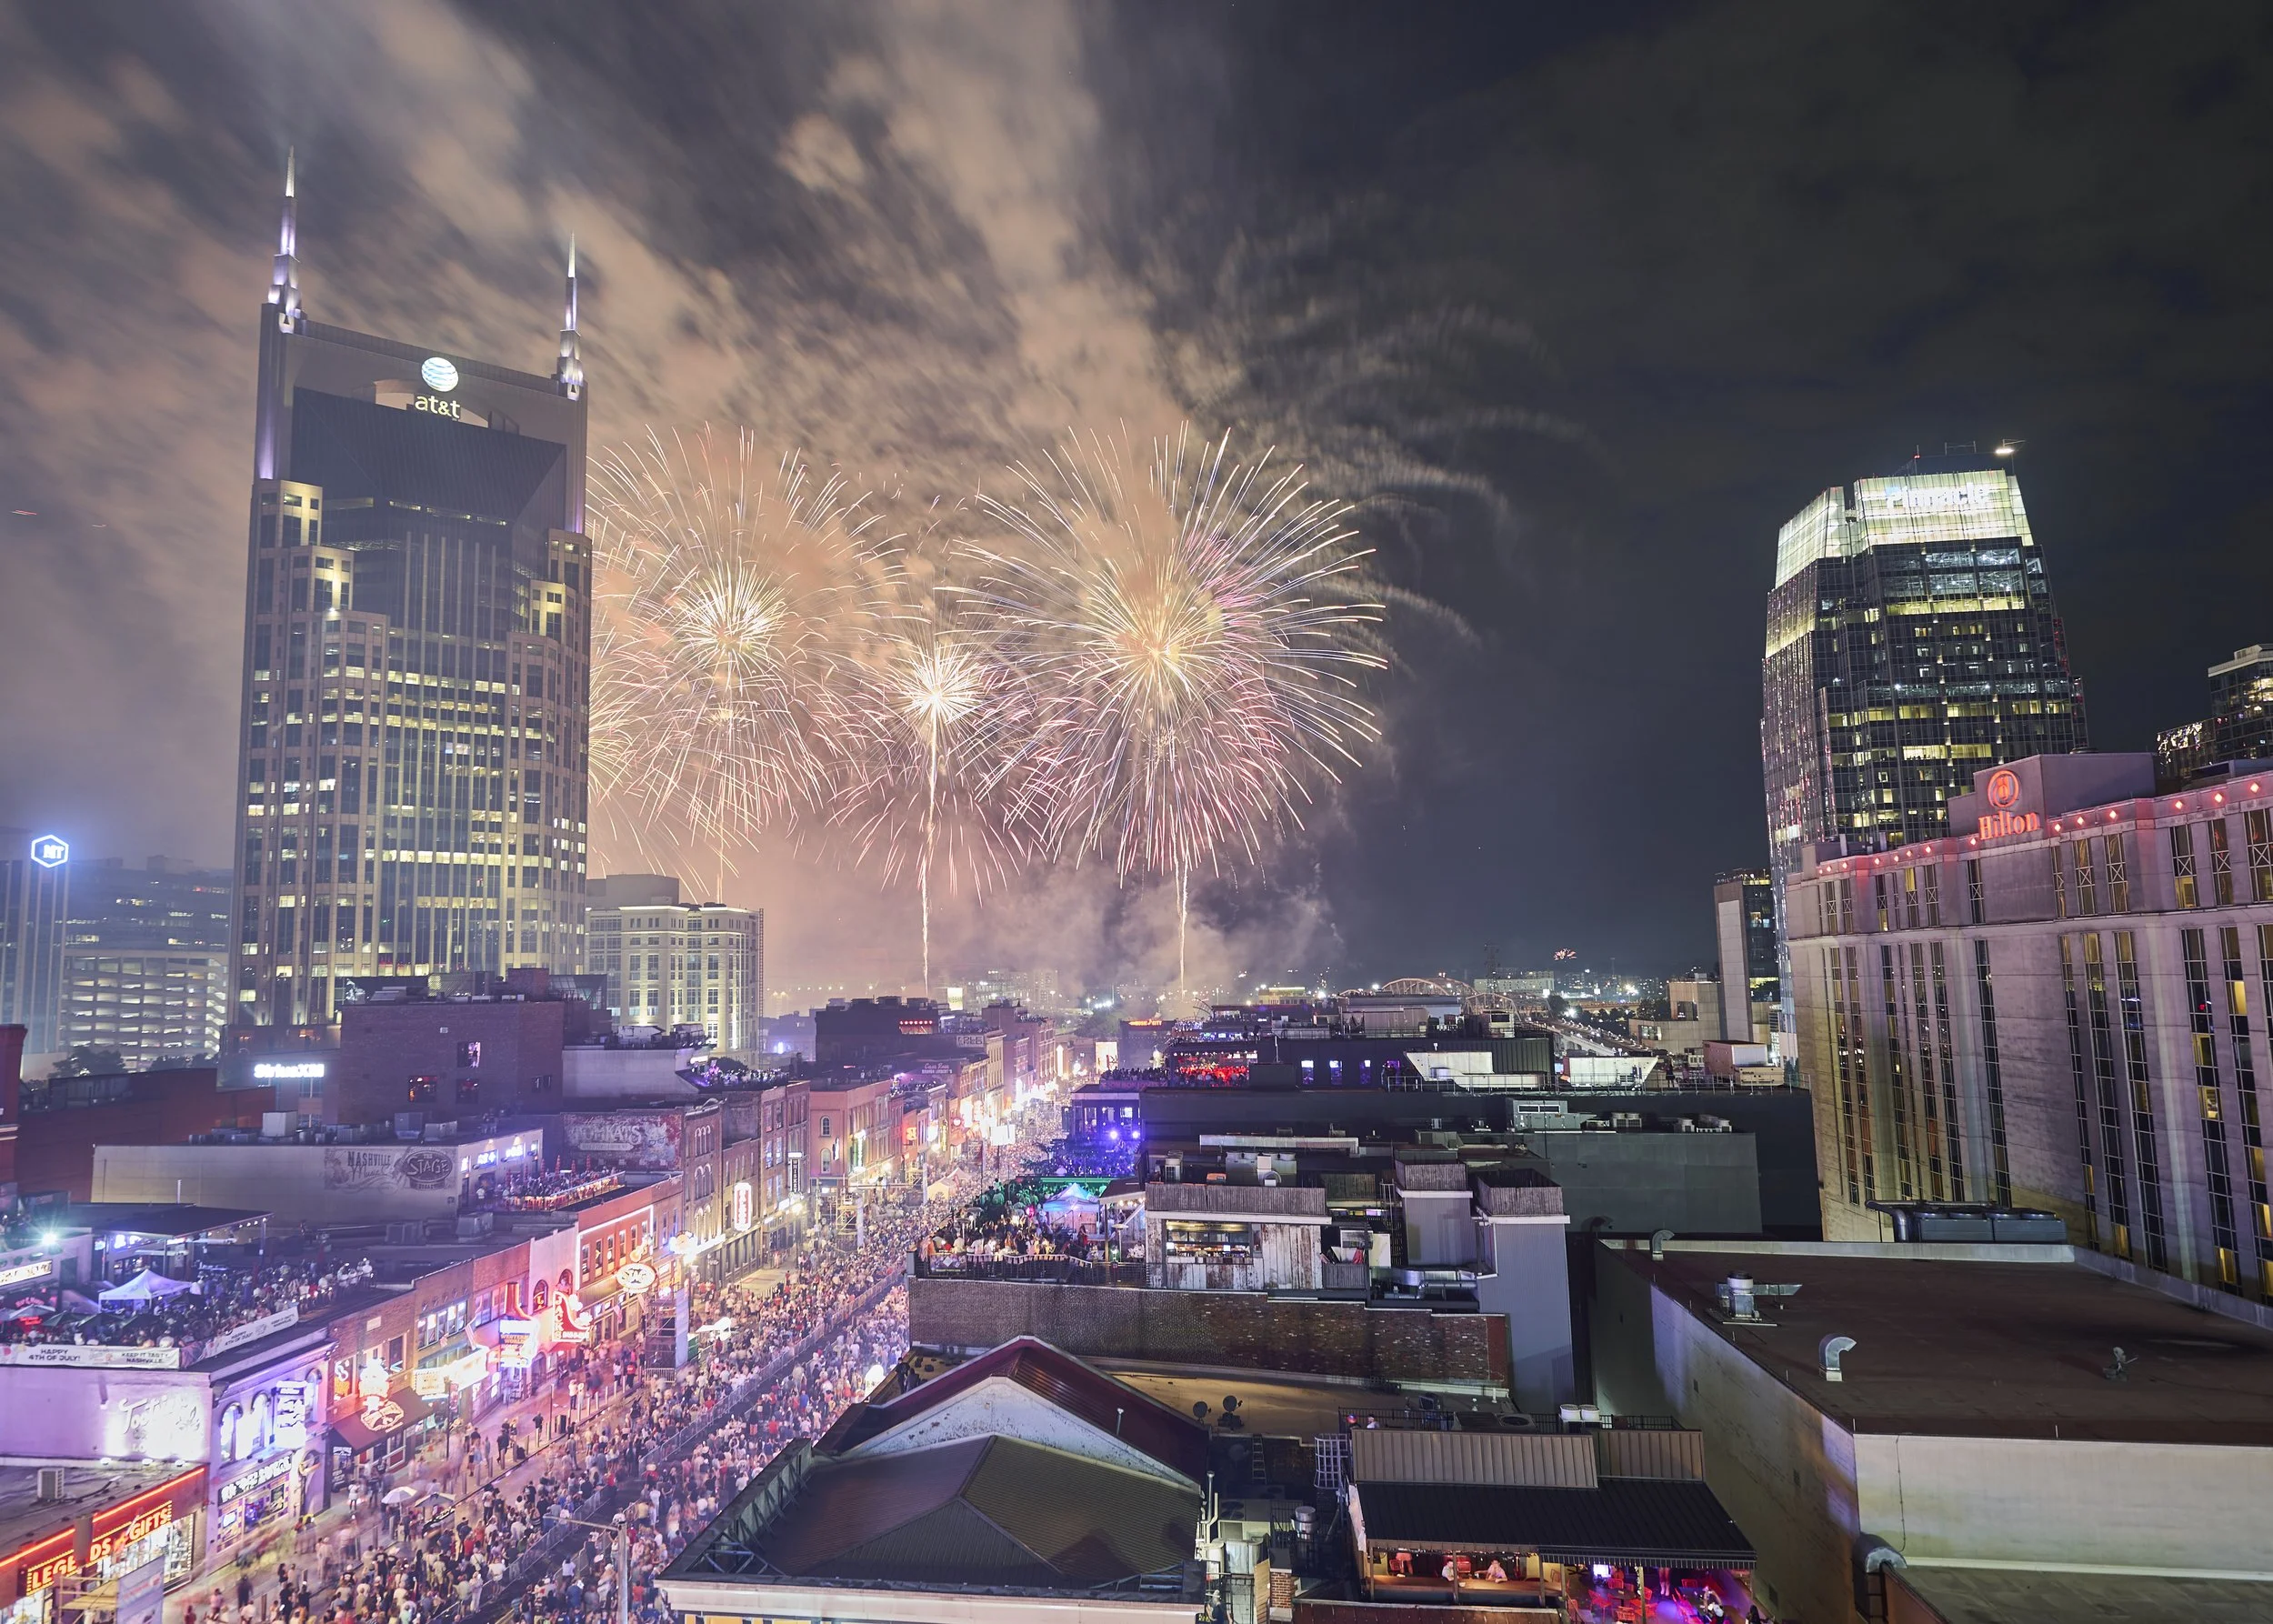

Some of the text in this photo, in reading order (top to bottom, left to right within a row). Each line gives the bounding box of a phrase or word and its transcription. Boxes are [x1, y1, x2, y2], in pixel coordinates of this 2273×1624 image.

[415, 395, 460, 419] at&t
[1978, 810, 2040, 840] Hilton
[347, 1150, 391, 1167] NASHVILLE
[406, 1156, 449, 1176] STAGE
[32, 1538, 112, 1589] LEGEDS
[129, 1508, 169, 1541] GIFTS
